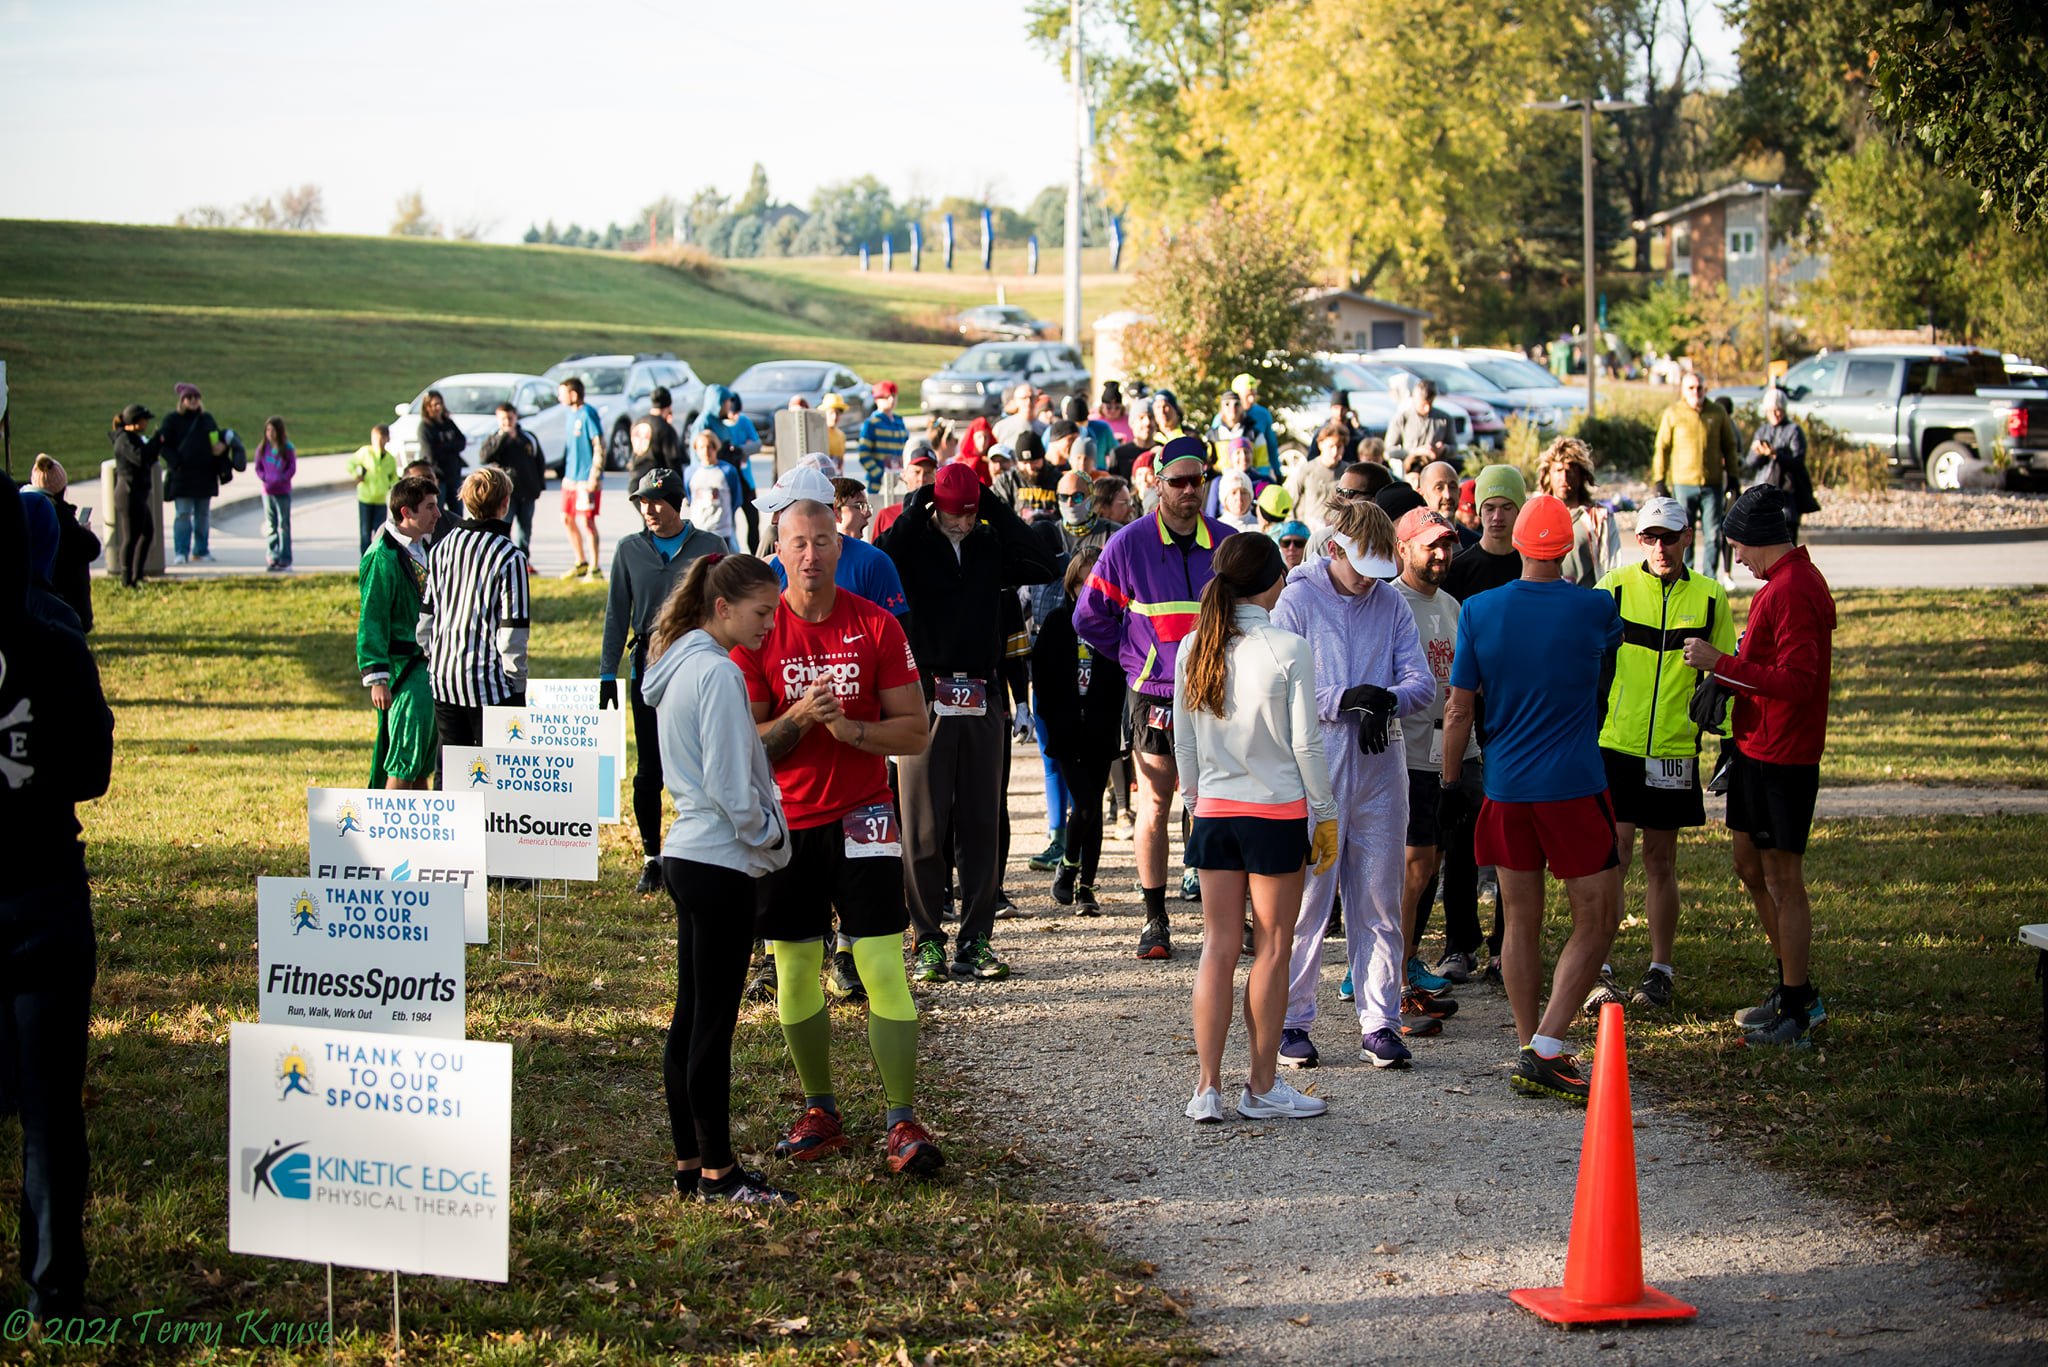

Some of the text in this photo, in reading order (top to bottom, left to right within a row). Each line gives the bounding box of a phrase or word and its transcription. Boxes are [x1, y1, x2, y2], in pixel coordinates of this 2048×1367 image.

[782, 661, 860, 684] Chicago
[544, 684, 598, 693] THANK YO
[952, 688, 970, 706] 32
[556, 694, 594, 702] TO OUR
[530, 714, 599, 726] THANK YOU
[1154, 707, 1172, 728] 71
[542, 725, 586, 736] TO OUR
[496, 754, 574, 768] THANK YOU
[1660, 758, 1682, 778] 106
[510, 768, 560, 780] TO OUR
[366, 797, 455, 812] THANK YOU
[383, 812, 440, 826] TO OUR
[866, 816, 888, 841] 37
[518, 836, 548, 846] America's
[418, 868, 474, 888] FEET
[326, 888, 430, 906] THANK YOU
[344, 906, 411, 924] TO OUR
[266, 964, 456, 1006] FitnessSports
[288, 1006, 432, 1022] Run, Walk, Work Out Etb. 1984
[325, 1043, 464, 1072] THANK YOU
[349, 1068, 438, 1093] TO OUR
[316, 1156, 497, 1198] KINETIC EDGE
[316, 1186, 498, 1220] PHYSICAL THERAPY
